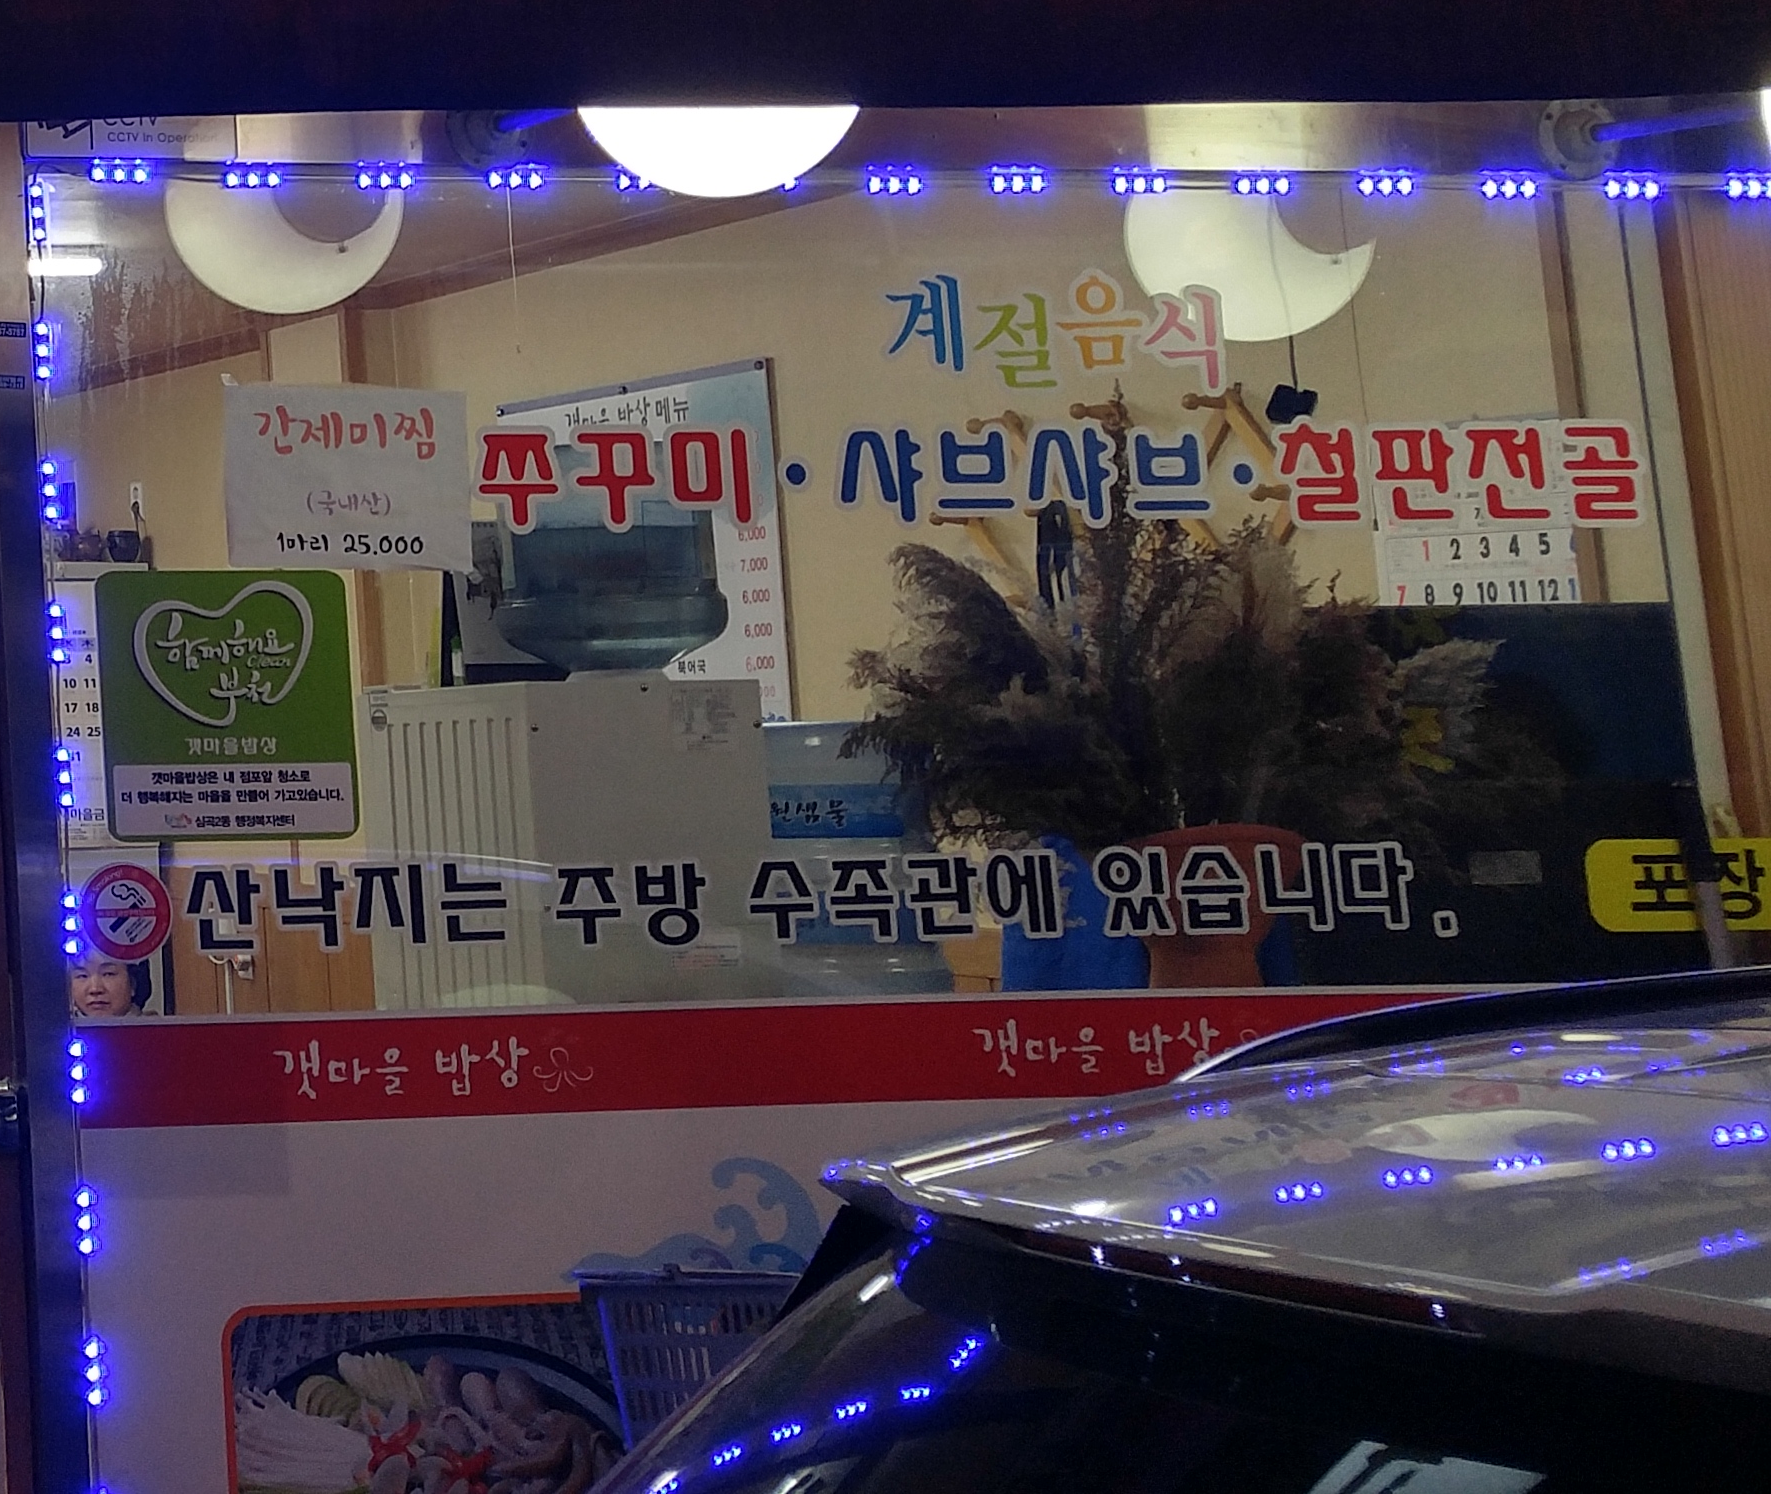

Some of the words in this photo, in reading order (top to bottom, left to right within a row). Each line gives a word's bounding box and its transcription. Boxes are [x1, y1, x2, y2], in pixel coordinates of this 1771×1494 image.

[107, 132, 139, 143] CCTV
[142, 132, 154, 143] In
[886, 273, 1224, 391] 계절음식
[655, 396, 689, 424] 메뉴
[253, 405, 436, 460] 간제미찜
[306, 490, 392, 517] (국내산)
[277, 531, 330, 554] 1마리
[343, 533, 425, 556] 25.000
[1422, 539, 1430, 562] 1
[1450, 538, 1462, 560] 2
[1479, 536, 1491, 559] 3
[1509, 534, 1521, 557] 4
[1538, 532, 1551, 556] 5
[740, 557, 769, 573] 7,000
[743, 589, 771, 604] 6,000
[1424, 583, 1435, 605] 8
[1453, 582, 1464, 606] 9
[1477, 580, 1499, 603] 10
[1508, 579, 1528, 602] 11
[1538, 578, 1560, 602] 12
[745, 622, 773, 638] 6,000
[677, 660, 706, 674] 북어국
[746, 655, 775, 672] 6,000
[63, 678, 77, 689] 10
[83, 678, 97, 689] 11
[64, 702, 79, 714] 17
[85, 702, 99, 713] 18
[66, 727, 81, 738] 24
[86, 726, 101, 738] 25
[185, 736, 278, 756] 갯마을밥상
[121, 792, 133, 804] 더
[185, 862, 510, 953] 산낙지는
[555, 861, 707, 947] 주방
[749, 849, 1058, 943] 수족관에
[1094, 841, 1459, 939] 있습니다.
[972, 1018, 1104, 1077] 갯마을
[1128, 1017, 1221, 1076] 밥상
[273, 1039, 411, 1100] 갯마을
[434, 1036, 531, 1096] 밥상
